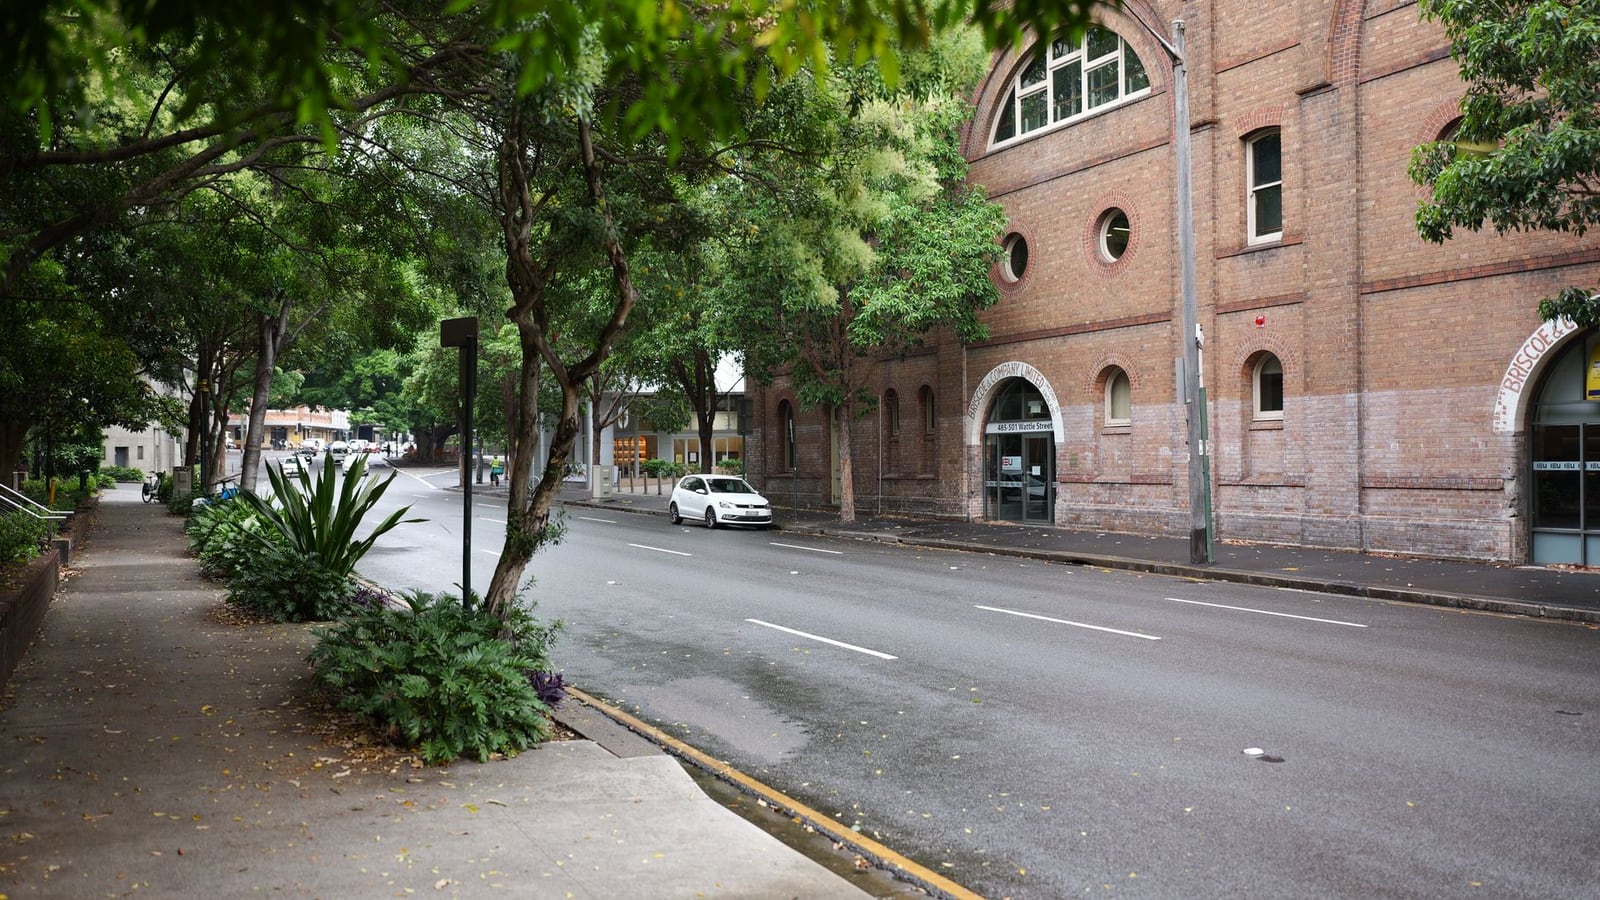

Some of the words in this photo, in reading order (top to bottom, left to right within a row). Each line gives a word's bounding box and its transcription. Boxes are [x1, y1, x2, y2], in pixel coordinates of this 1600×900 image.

[1502, 328, 1552, 393] BRISCOE
[968, 381, 988, 420] BRISCOE
[990, 362, 1021, 383] COMPANY
[1021, 363, 1045, 388] LIMITED
[1018, 422, 1036, 431] Wattle
[1036, 421, 1053, 430] Street
